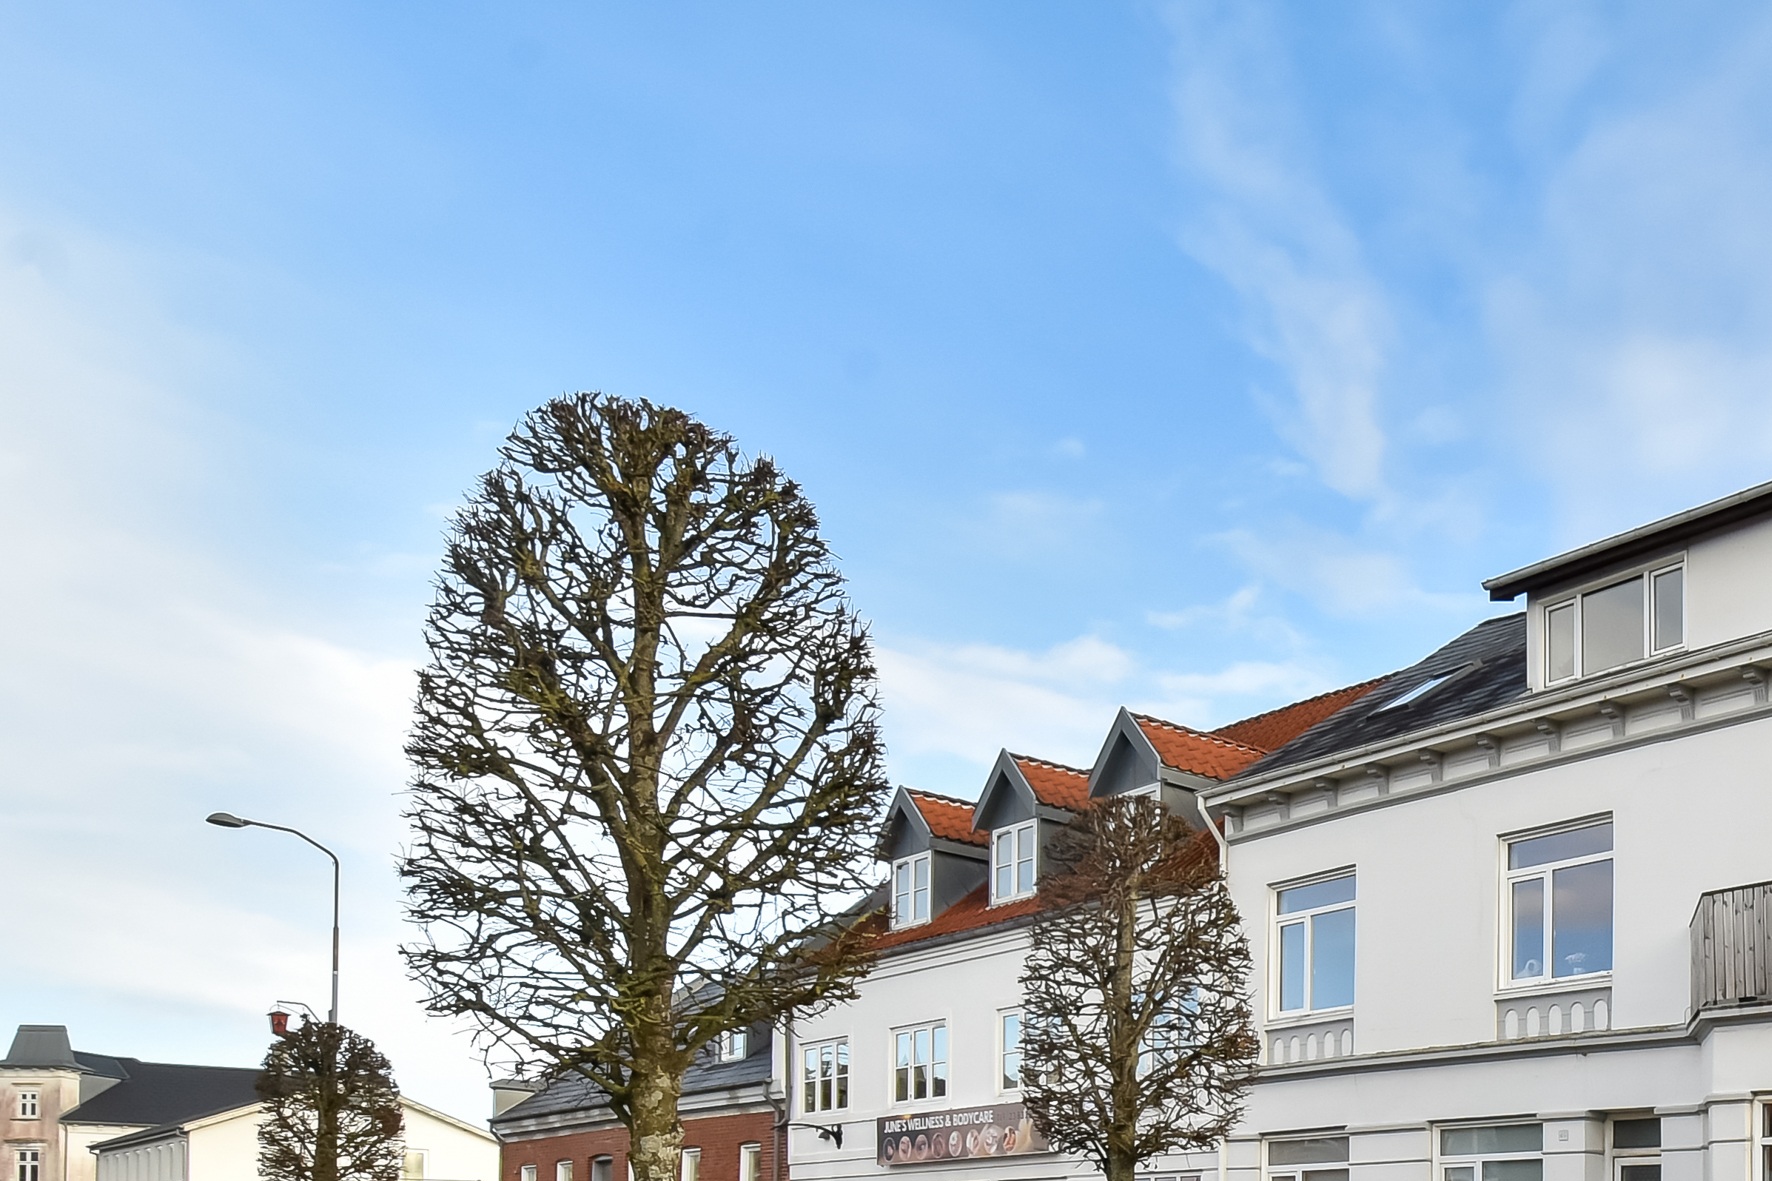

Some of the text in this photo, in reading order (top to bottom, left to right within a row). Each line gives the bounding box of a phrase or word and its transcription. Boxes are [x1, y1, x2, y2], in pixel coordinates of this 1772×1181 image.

[884, 1120, 907, 1134] JUNE'S
[908, 1116, 944, 1131] WELLNESS
[945, 1115, 951, 1127] &
[953, 1110, 995, 1126] BODYCARE
